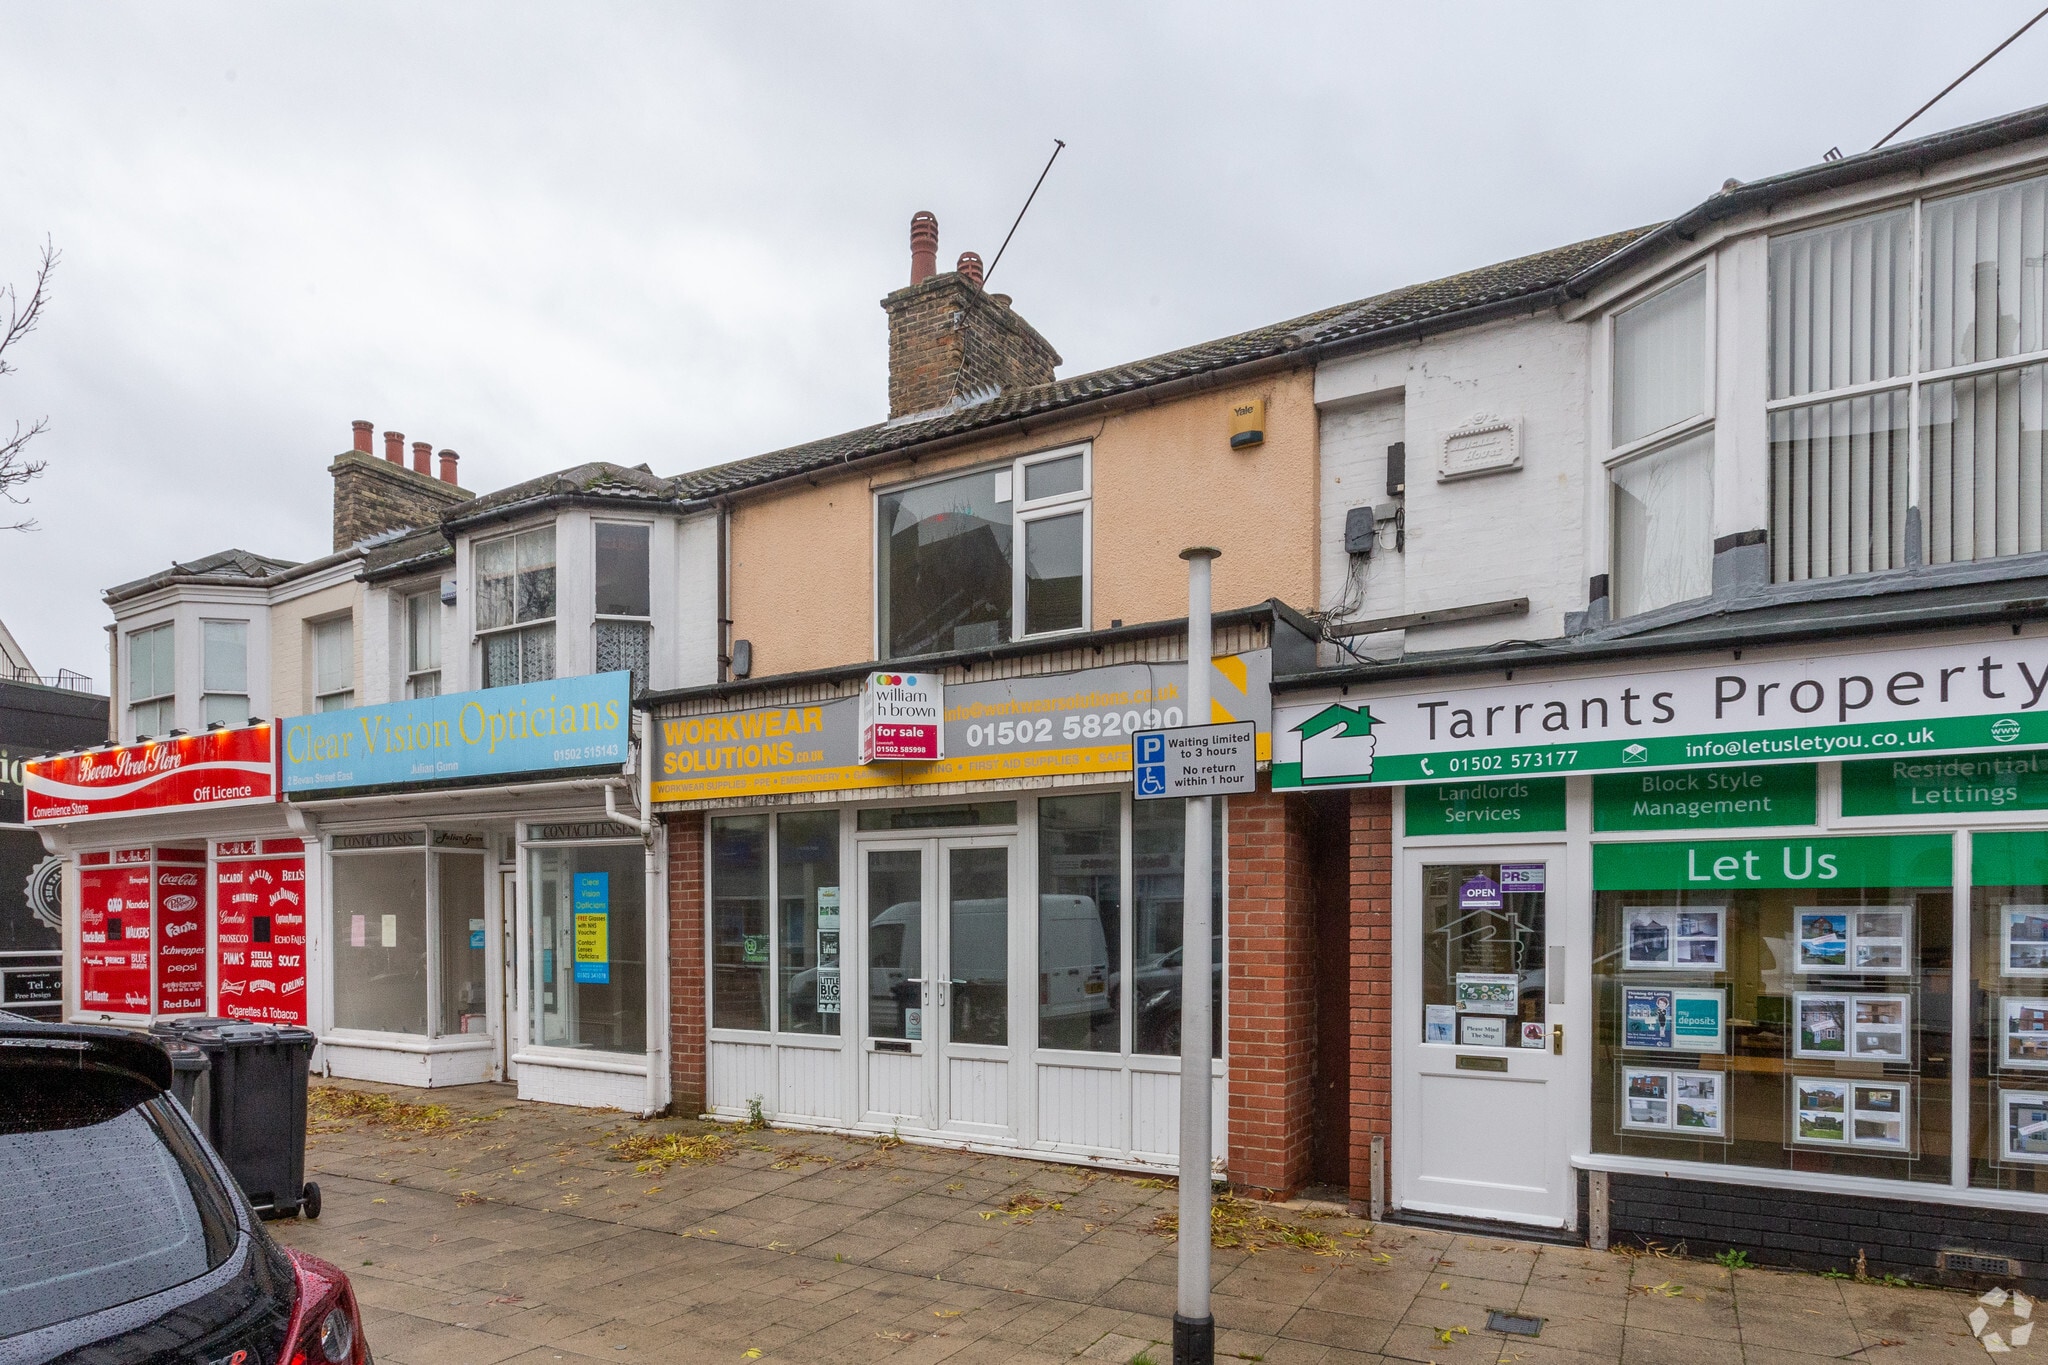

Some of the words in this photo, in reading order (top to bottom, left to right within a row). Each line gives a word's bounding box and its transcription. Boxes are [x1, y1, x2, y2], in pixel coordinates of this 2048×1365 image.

[1234, 406, 1253, 416] Yale
[876, 688, 927, 703] william
[944, 683, 1178, 722] info@workwearsolutions.co.uk
[1417, 687, 1675, 740] Tarrants
[1715, 656, 2048, 722] Property
[878, 703, 886, 716] h
[891, 703, 936, 717] brown
[287, 725, 353, 765] Clear
[360, 713, 451, 755] Vision
[459, 695, 619, 754] Opticians
[663, 707, 823, 746] WORKWEAR
[877, 726, 896, 736] for
[900, 727, 924, 737] sale
[966, 718, 1052, 747] 01502
[1062, 706, 1183, 740] 582090
[1168, 737, 1208, 748] Waiting
[1212, 733, 1250, 745] limited
[1686, 727, 1935, 758] info@letusletyou.co.uk
[553, 747, 582, 762] 01502
[584, 744, 618, 759] 515143
[1144, 738, 1160, 761] P
[1181, 750, 1191, 758] to
[1195, 748, 1202, 757] 3
[1207, 747, 1237, 756] hours
[113, 749, 150, 777] Street
[148, 744, 181, 771] Store
[410, 763, 434, 775] Julian
[436, 762, 459, 772] Gunn
[1450, 756, 1502, 772] 01502
[1511, 751, 1578, 769] 573177
[1893, 754, 2039, 779] Residential
[315, 773, 336, 783] Street
[337, 772, 353, 781] East
[658, 782, 704, 794] WORKWEAR
[707, 779, 746, 791] SUPPLIES
[754, 777, 770, 787] PPE
[781, 773, 840, 785] EMBROIDERY
[969, 760, 999, 772] FIRST
[1002, 759, 1021, 769] AID
[1024, 754, 1079, 768] SUPPLIES
[1183, 766, 1198, 775] No
[1202, 764, 1236, 774] return
[1175, 777, 1207, 786] within
[1211, 776, 1215, 784] 1
[1220, 775, 1244, 784] hour
[1642, 774, 1701, 792] Block
[1707, 772, 1763, 793] Style
[193, 786, 211, 802] Off
[212, 785, 251, 800] Licence
[1438, 783, 1529, 801] Landlords
[1911, 785, 2018, 805] Lettings
[33, 804, 71, 818] Convenience
[71, 802, 89, 814] Store
[1445, 807, 1521, 823] Services
[1633, 796, 1772, 818] Management
[543, 824, 590, 838] CONTACT
[594, 822, 636, 836] LENSES
[343, 834, 381, 848] CONTACT
[1688, 849, 1761, 881] Let
[1783, 846, 1838, 880] Us
[249, 869, 273, 885] MALIBU
[1502, 871, 1530, 881] PRS
[1467, 889, 1495, 897] OPEN
[219, 934, 249, 943] PROSECCO
[274, 935, 290, 944] ECHO
[290, 935, 306, 945] FALLS
[160, 945, 205, 956] Schweppes
[250, 951, 273, 959] STELLA
[167, 963, 197, 973] pepsi
[250, 960, 273, 968] ARTOIS
[28, 981, 44, 990] Tel
[281, 976, 305, 994] CARLING
[820, 985, 840, 995] BIG
[163, 999, 182, 1009] Red
[183, 998, 201, 1007] Bull
[227, 1004, 261, 1018] Cigarettes
[262, 1007, 268, 1018] &
[268, 1007, 298, 1020] Tobacco
[1678, 1016, 1715, 1025] deposits
